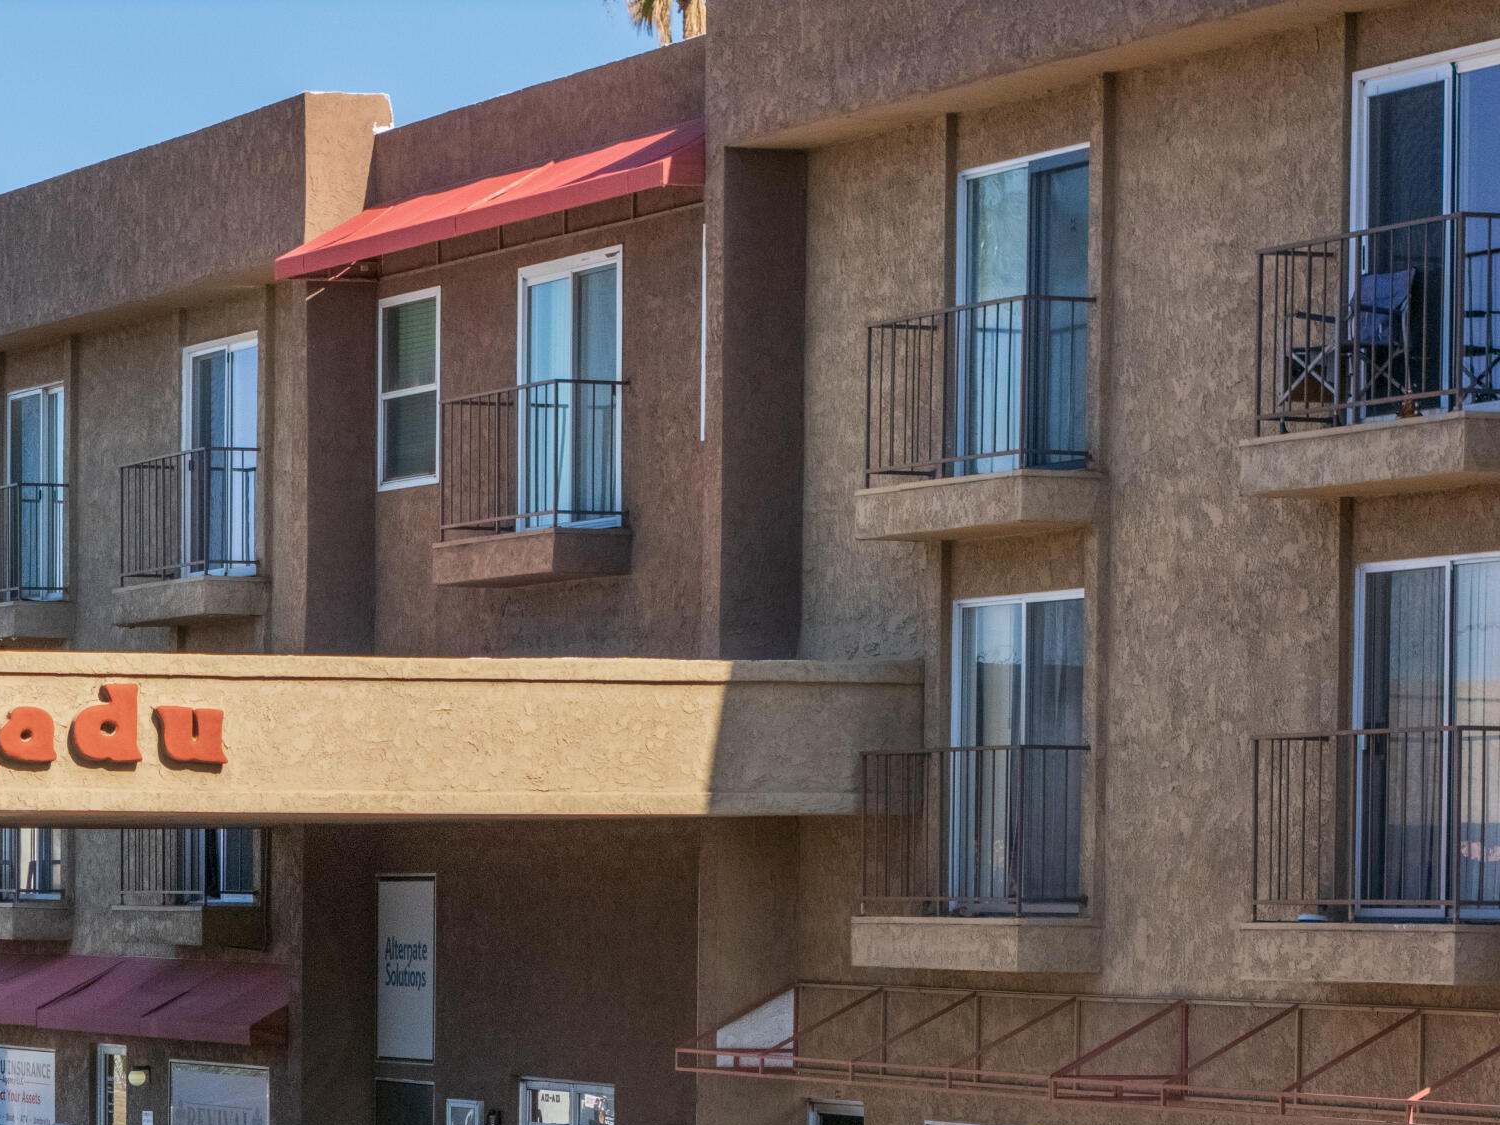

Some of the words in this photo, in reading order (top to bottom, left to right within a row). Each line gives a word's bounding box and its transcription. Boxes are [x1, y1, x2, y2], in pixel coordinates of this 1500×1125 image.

[385, 937, 427, 967] Alternate
[385, 962, 426, 991] Solutions
[8, 1061, 51, 1079] INSURANCE
